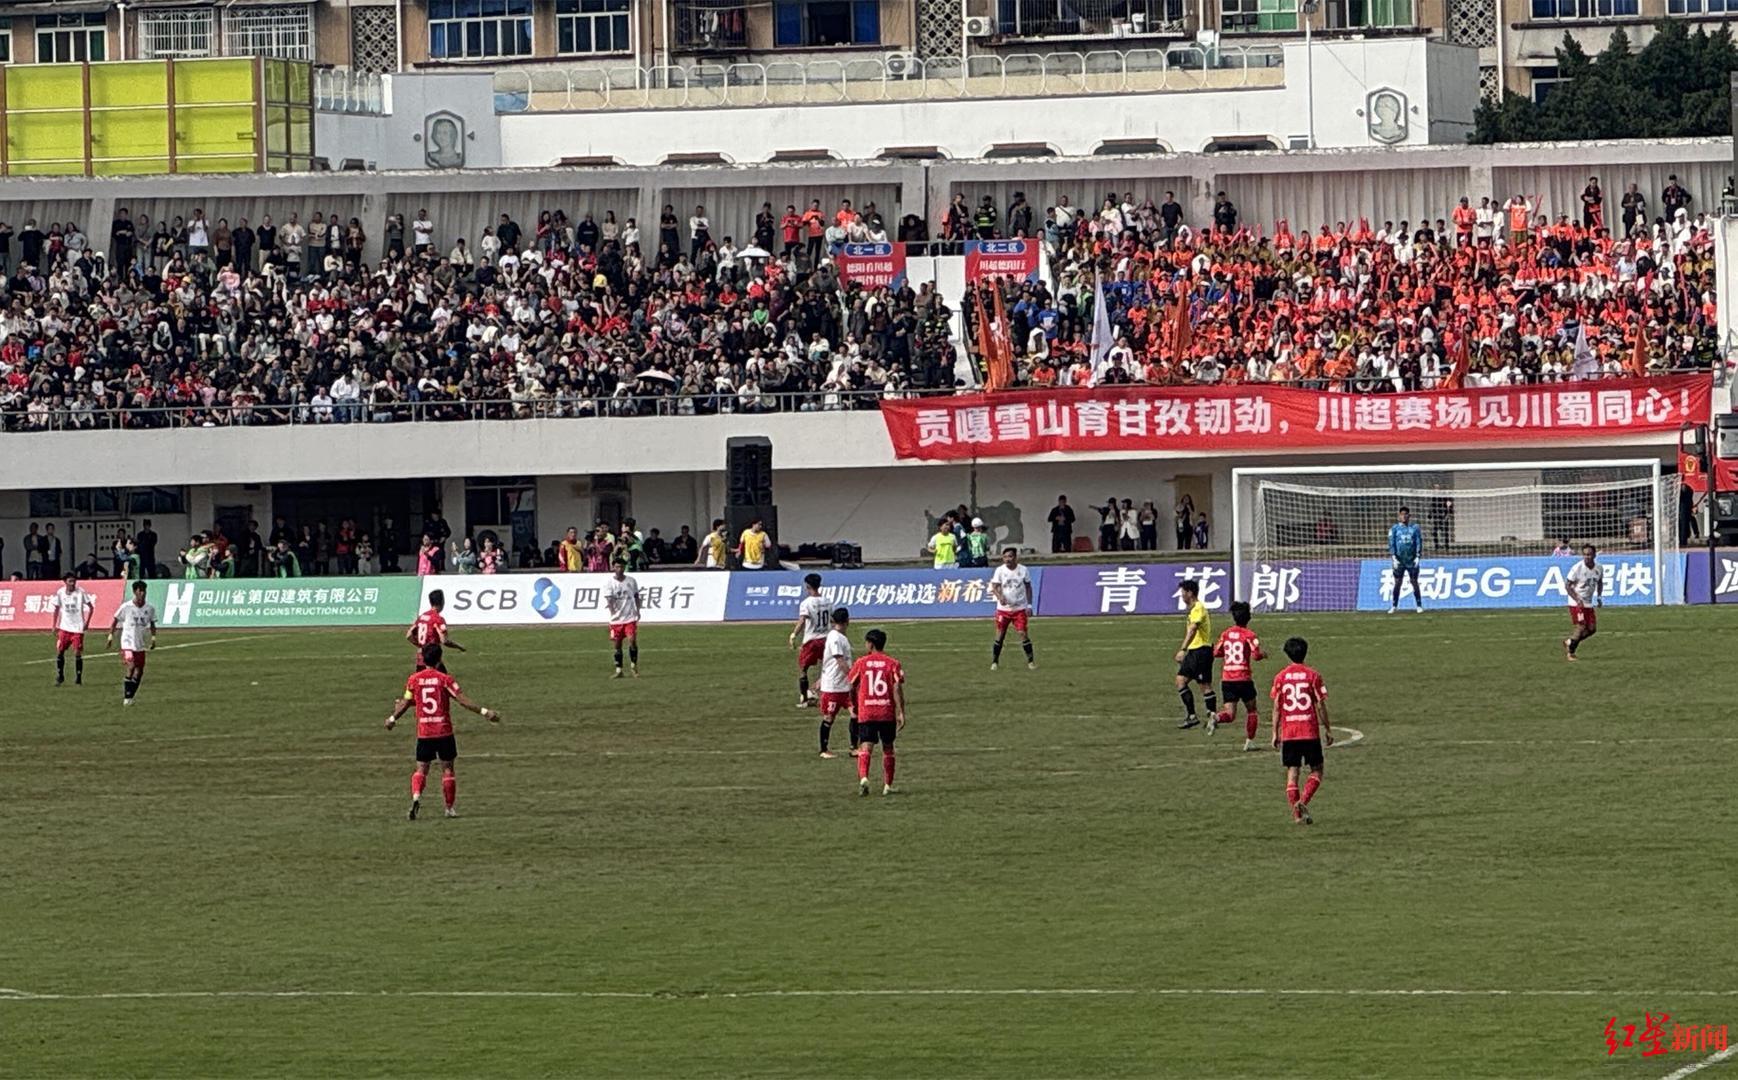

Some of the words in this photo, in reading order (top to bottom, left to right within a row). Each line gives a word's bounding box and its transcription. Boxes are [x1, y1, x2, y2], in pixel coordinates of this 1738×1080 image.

[852, 244, 885, 255] 北一区
[986, 242, 1018, 253] 北二区
[197, 587, 379, 605] 四川省第四建筑有限公司
[452, 588, 518, 611] SCB
[572, 586, 696, 610] 四银行
[1095, 563, 1302, 614] 青花郎
[816, 609, 829, 627] 10
[865, 670, 888, 696] 16
[421, 686, 438, 714] 5
[1281, 682, 1312, 711] 35
